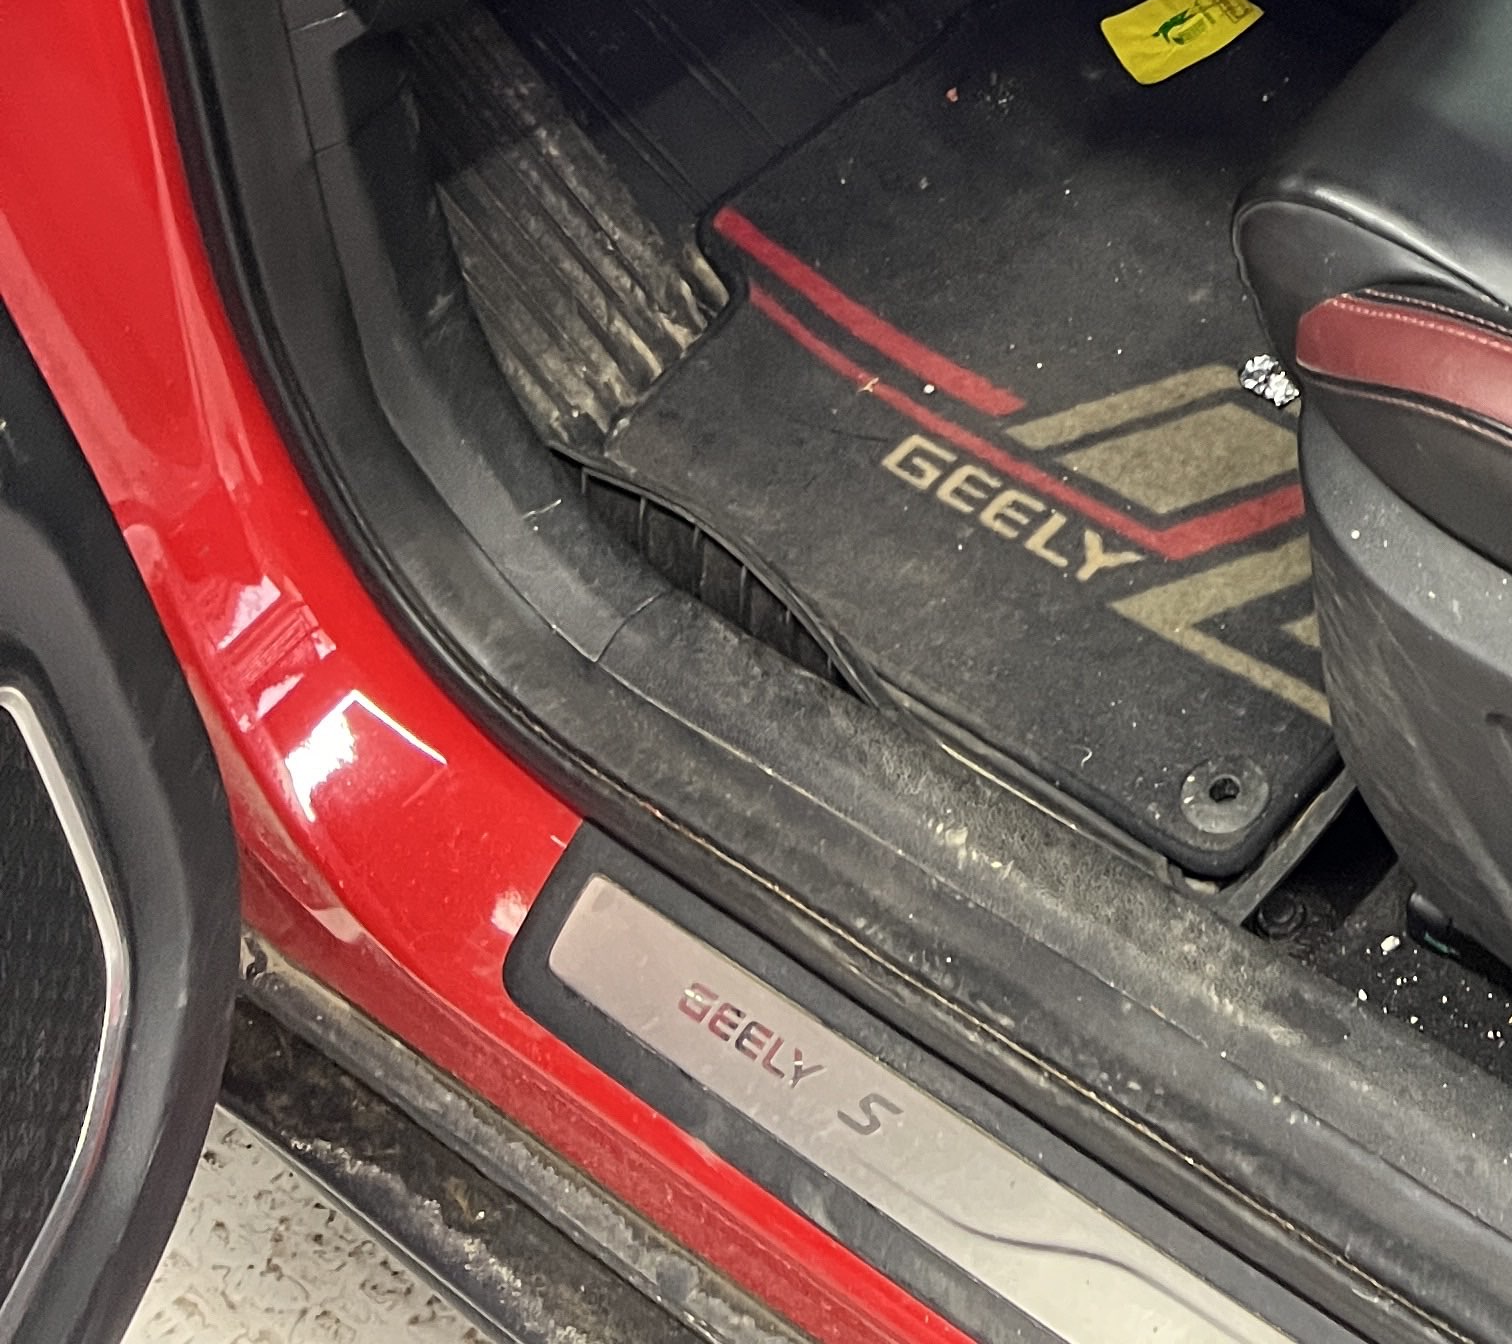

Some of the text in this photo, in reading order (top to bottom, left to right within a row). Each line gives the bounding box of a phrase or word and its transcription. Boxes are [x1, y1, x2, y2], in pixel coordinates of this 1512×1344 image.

[880, 432, 1145, 584] GEELY
[678, 981, 903, 1137] GEELY S
